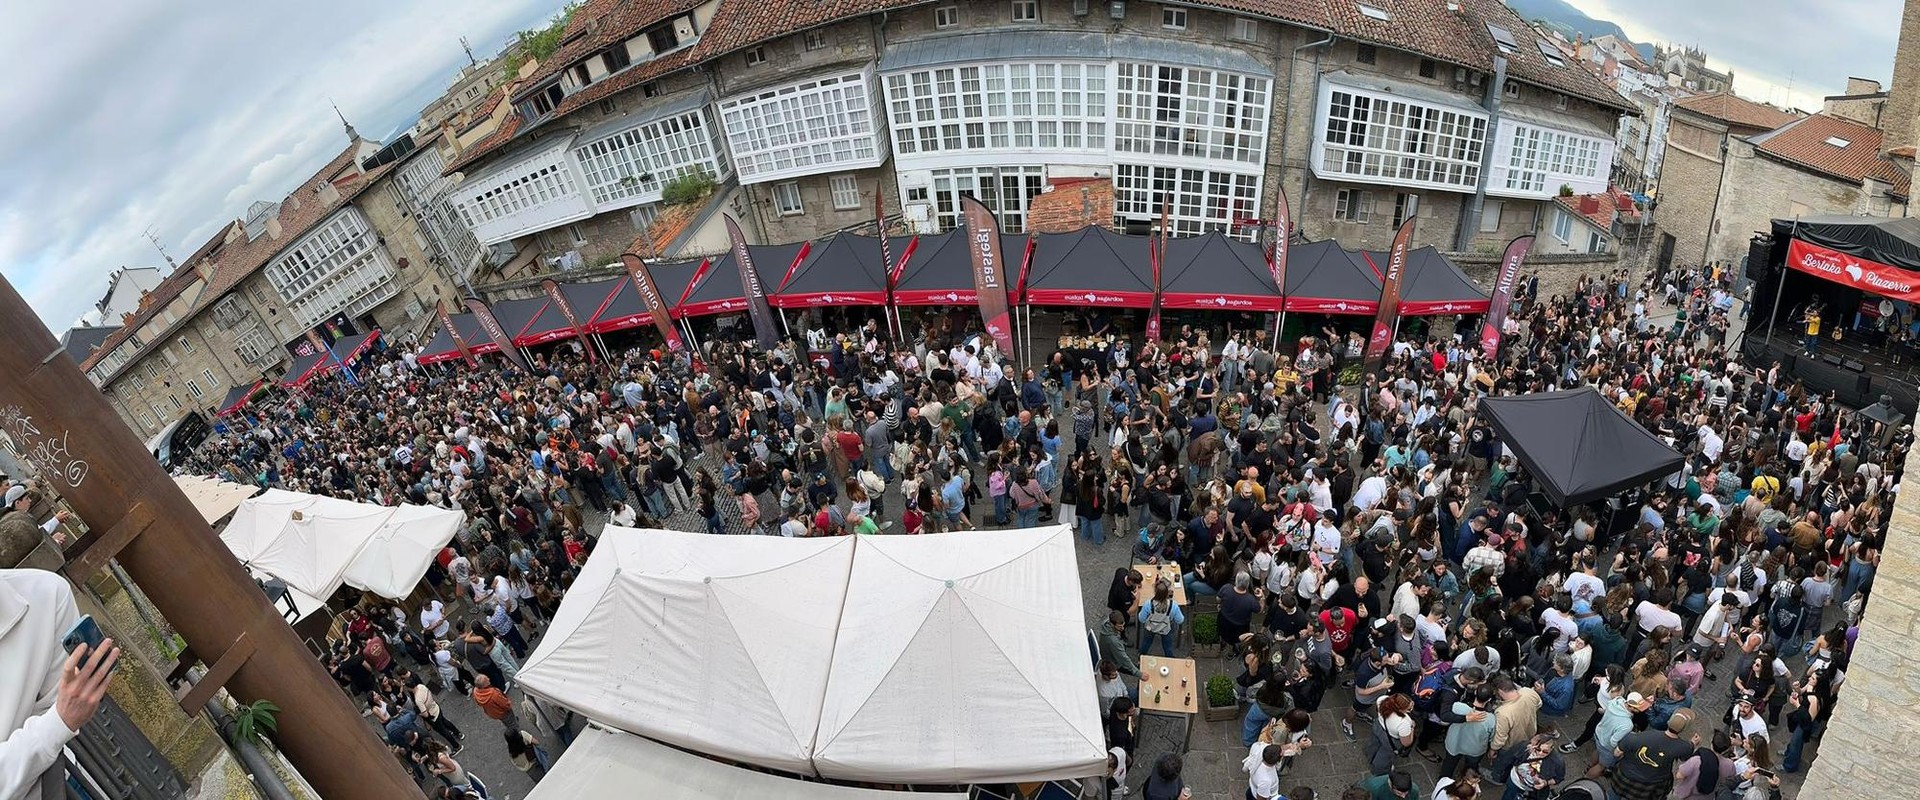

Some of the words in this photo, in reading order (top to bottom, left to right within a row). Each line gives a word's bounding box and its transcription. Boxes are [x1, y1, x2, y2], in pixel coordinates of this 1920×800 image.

[1388, 243, 1403, 280] Añota
[1498, 254, 1518, 294] Altuna
[1865, 272, 1912, 293] Plazerra
